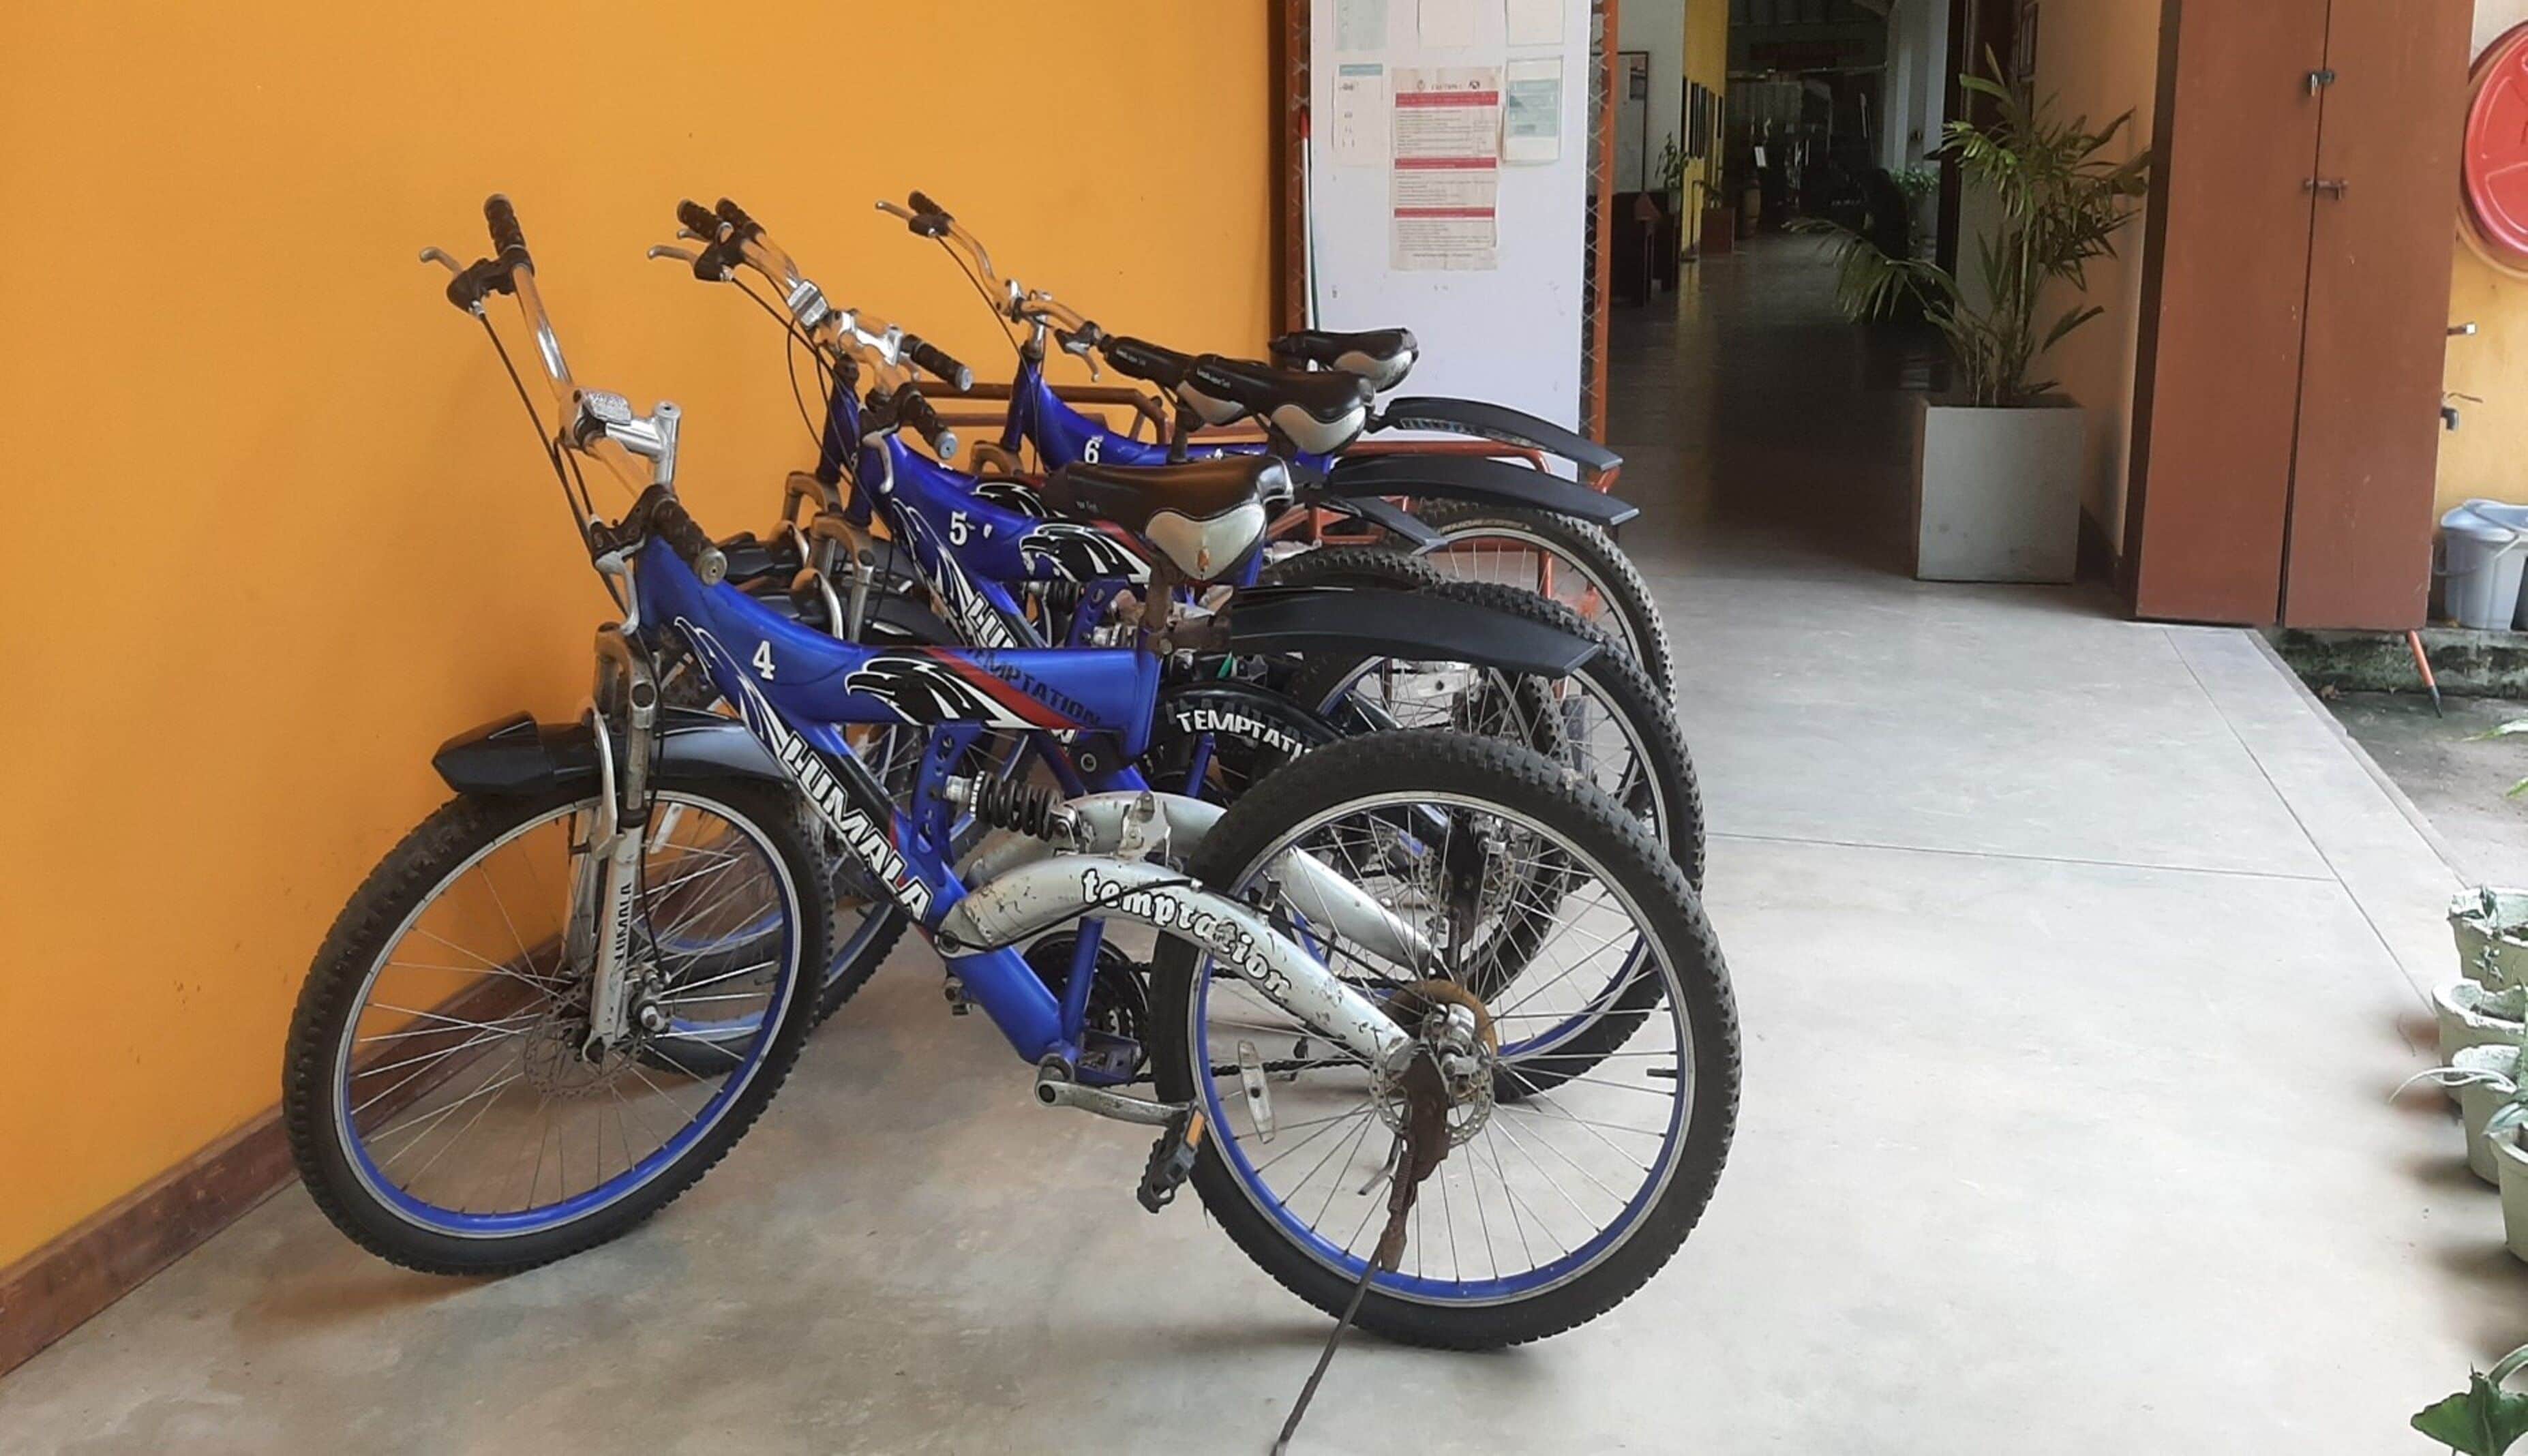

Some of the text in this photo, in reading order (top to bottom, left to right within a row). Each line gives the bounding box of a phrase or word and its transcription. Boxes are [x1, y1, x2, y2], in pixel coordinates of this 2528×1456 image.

[1084, 438, 1100, 464] 6
[949, 510, 968, 546] 5
[752, 640, 776, 681] 4
[1176, 709, 1314, 763] TEMPTATI
[778, 731, 933, 923] LUMALA
[1081, 867, 1294, 1003] temptation
